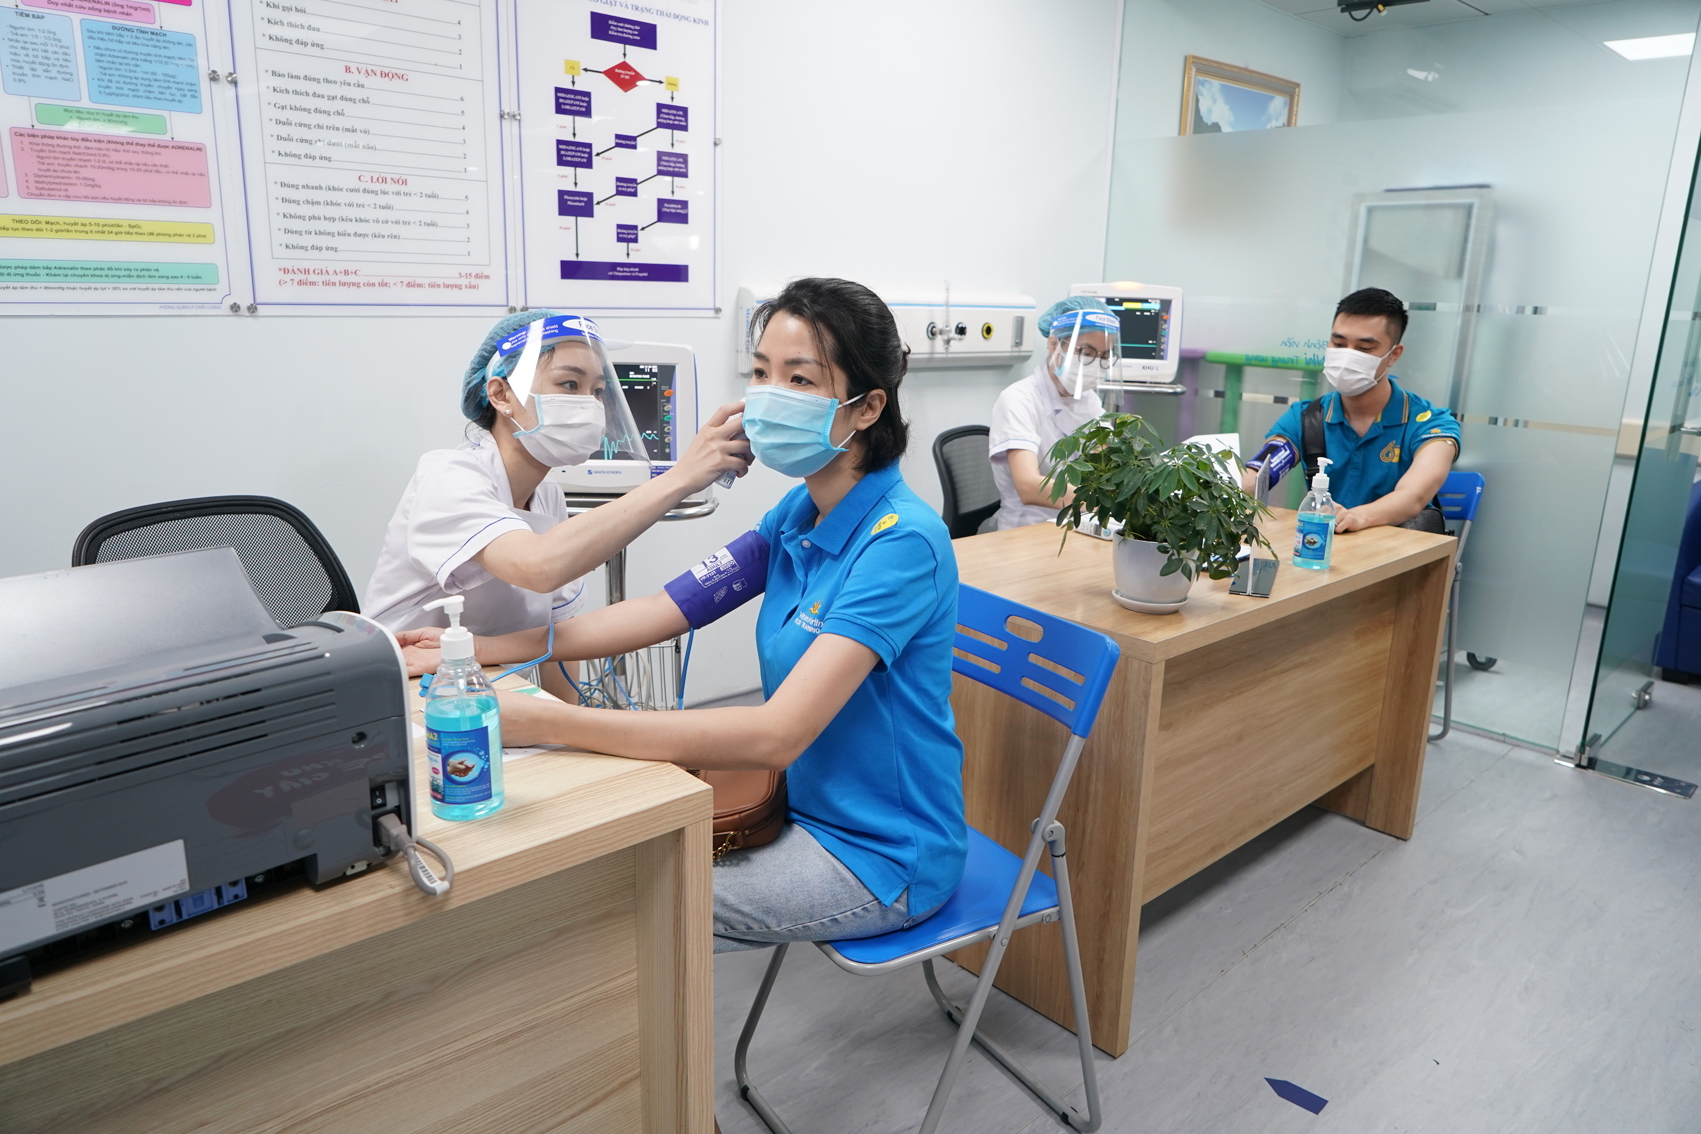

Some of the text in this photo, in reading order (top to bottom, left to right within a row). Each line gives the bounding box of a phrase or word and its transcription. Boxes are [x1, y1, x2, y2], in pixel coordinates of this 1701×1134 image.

[267, 18, 284, 26] Kích
[693, 18, 709, 26] KINH
[269, 34, 324, 49] Không đáp ứng
[345, 65, 409, 82] B. VẬN ĐỘNG
[303, 74, 321, 83] đúng
[340, 80, 351, 88] yêu
[272, 86, 290, 94] Kích
[340, 95, 356, 104] đúng
[274, 103, 287, 111] Gạt
[290, 104, 312, 114] không
[313, 107, 331, 116] đúng
[294, 121, 312, 129] cứng
[296, 137, 312, 145] cứng
[278, 150, 301, 160] Không
[304, 153, 316, 161] đáp
[358, 174, 408, 186] C. LỜI NÓI
[280, 181, 299, 190] Đúng
[282, 197, 301, 205] Đúng
[303, 198, 321, 206] chậm
[285, 243, 308, 251] Không
[310, 244, 323, 252] đáp
[313, 267, 330, 276] GIÁ
[701, 554, 719, 572] 13
